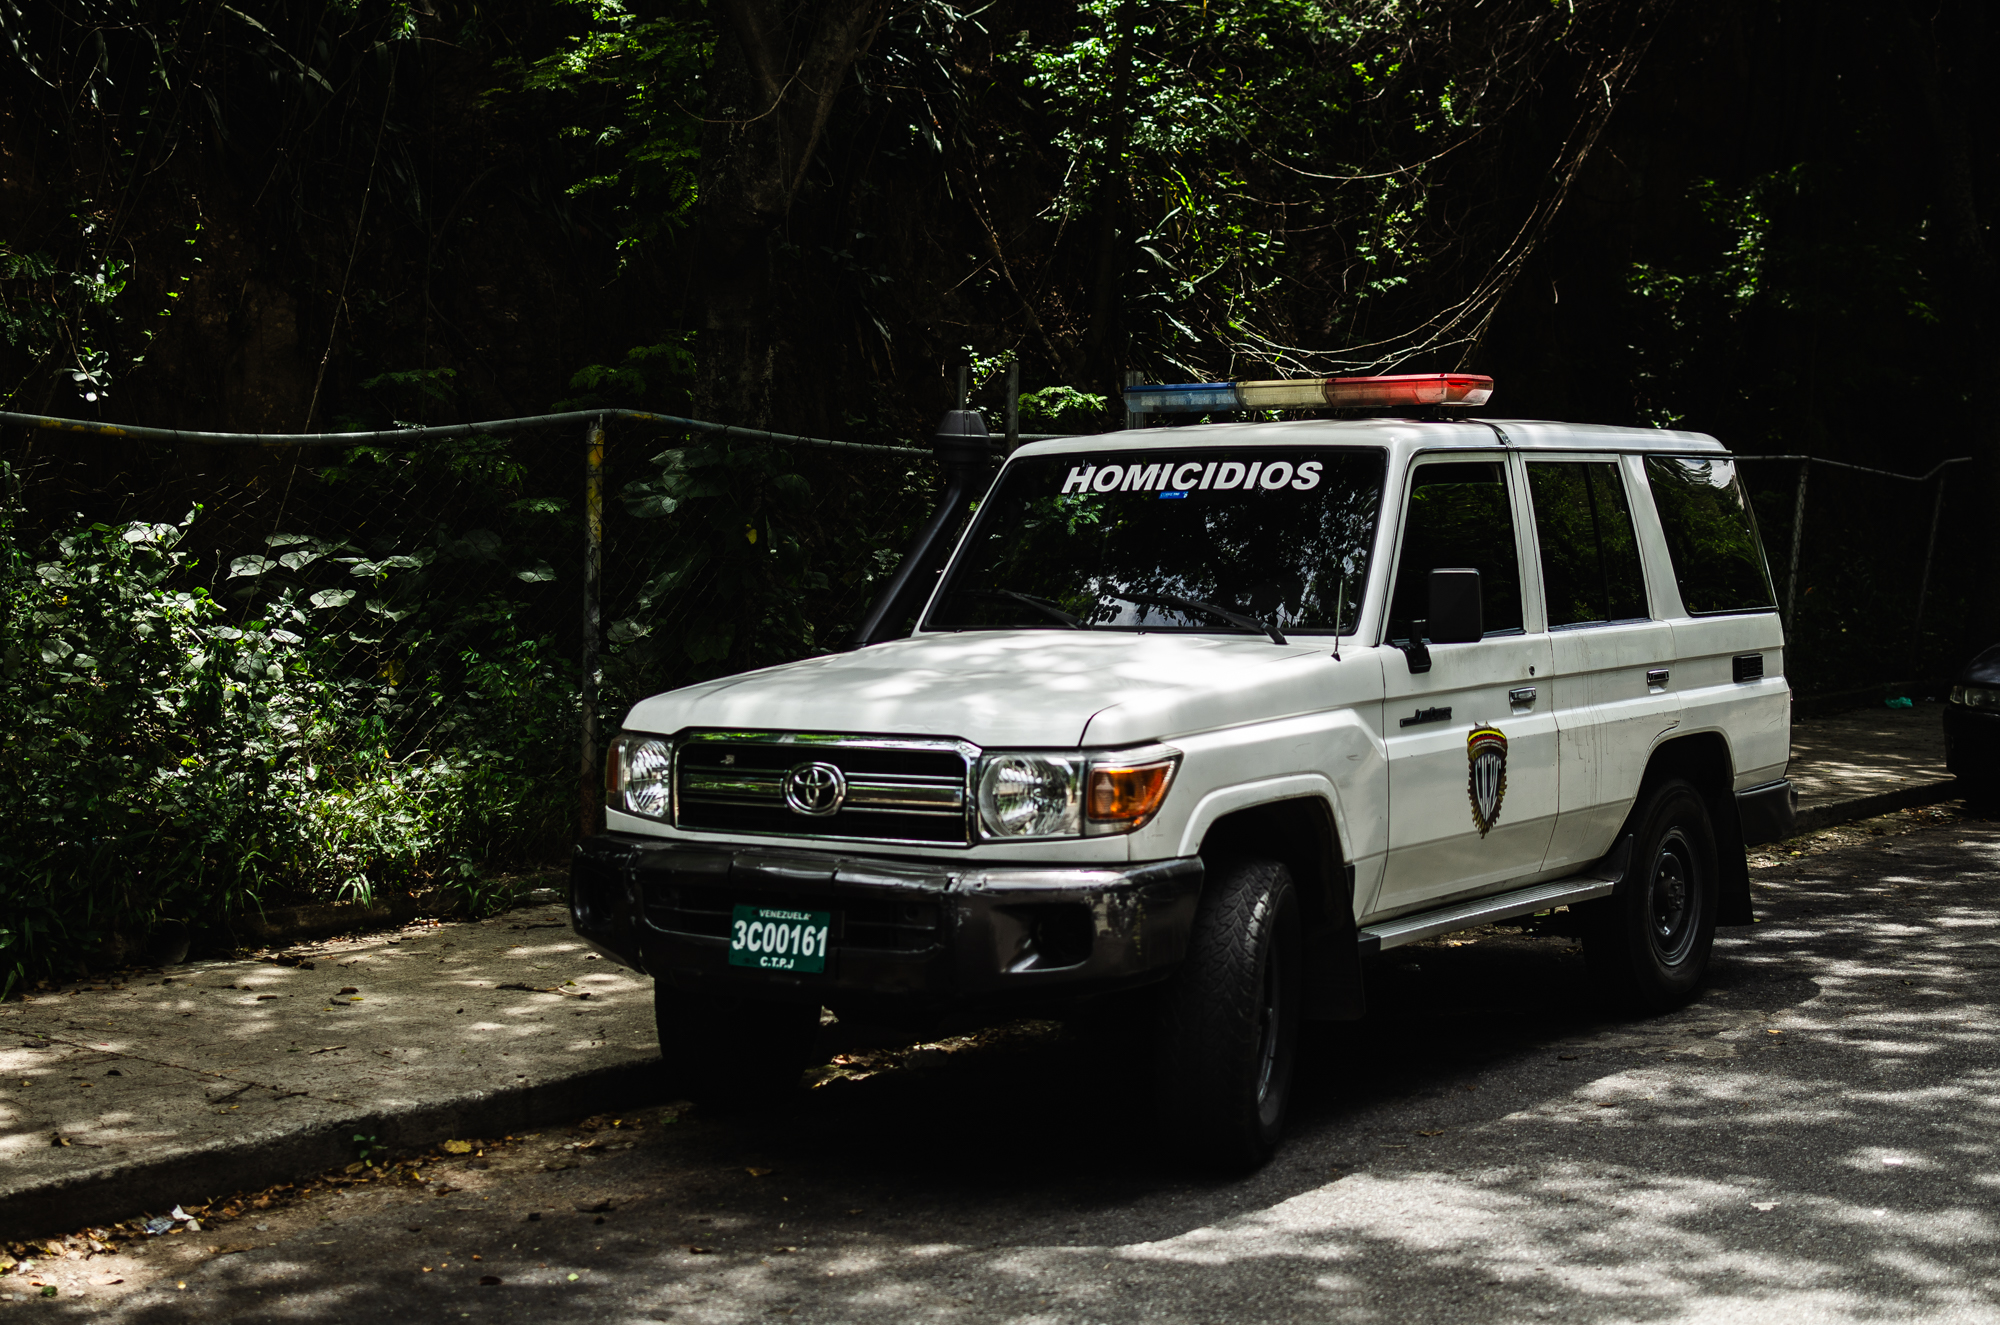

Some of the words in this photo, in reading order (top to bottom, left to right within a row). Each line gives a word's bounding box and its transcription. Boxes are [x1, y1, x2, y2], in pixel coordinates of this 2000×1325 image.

[1061, 461, 1323, 493] HOMICIDIOS
[759, 909, 811, 920] VENEZUELA
[732, 920, 828, 957] 3C00161
